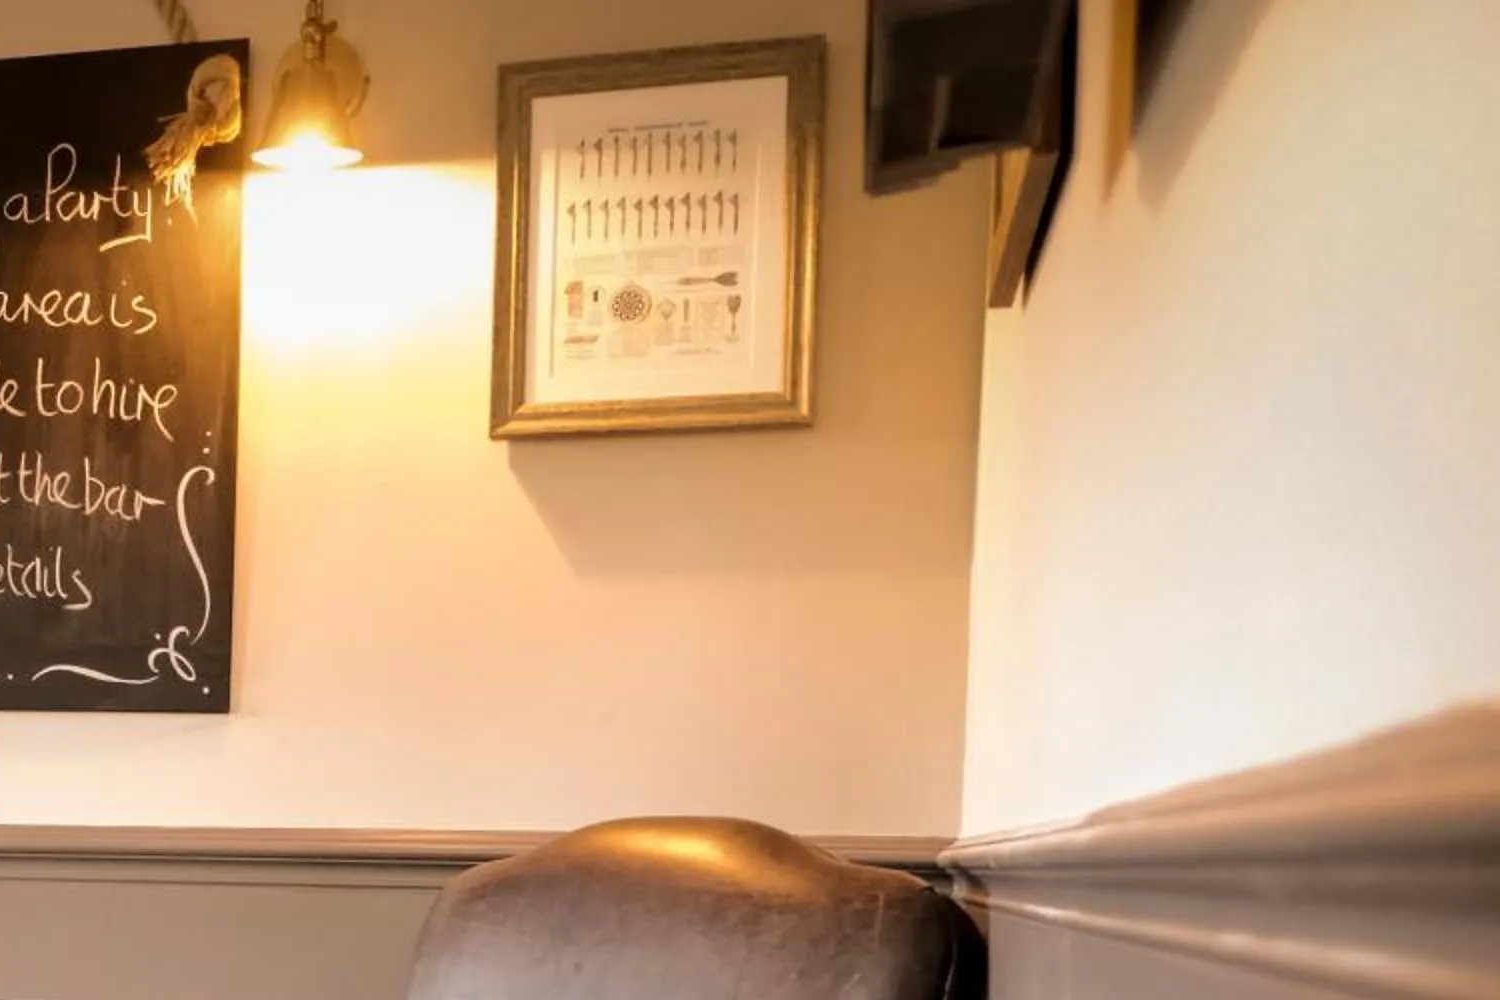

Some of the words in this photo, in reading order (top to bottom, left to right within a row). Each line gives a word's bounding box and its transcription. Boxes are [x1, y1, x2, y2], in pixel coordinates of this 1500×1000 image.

[2, 199, 42, 224] a
[110, 281, 158, 335] is
[36, 357, 84, 418] to
[92, 357, 179, 443] hire
[18, 451, 81, 508] the
[83, 456, 166, 522] bar
